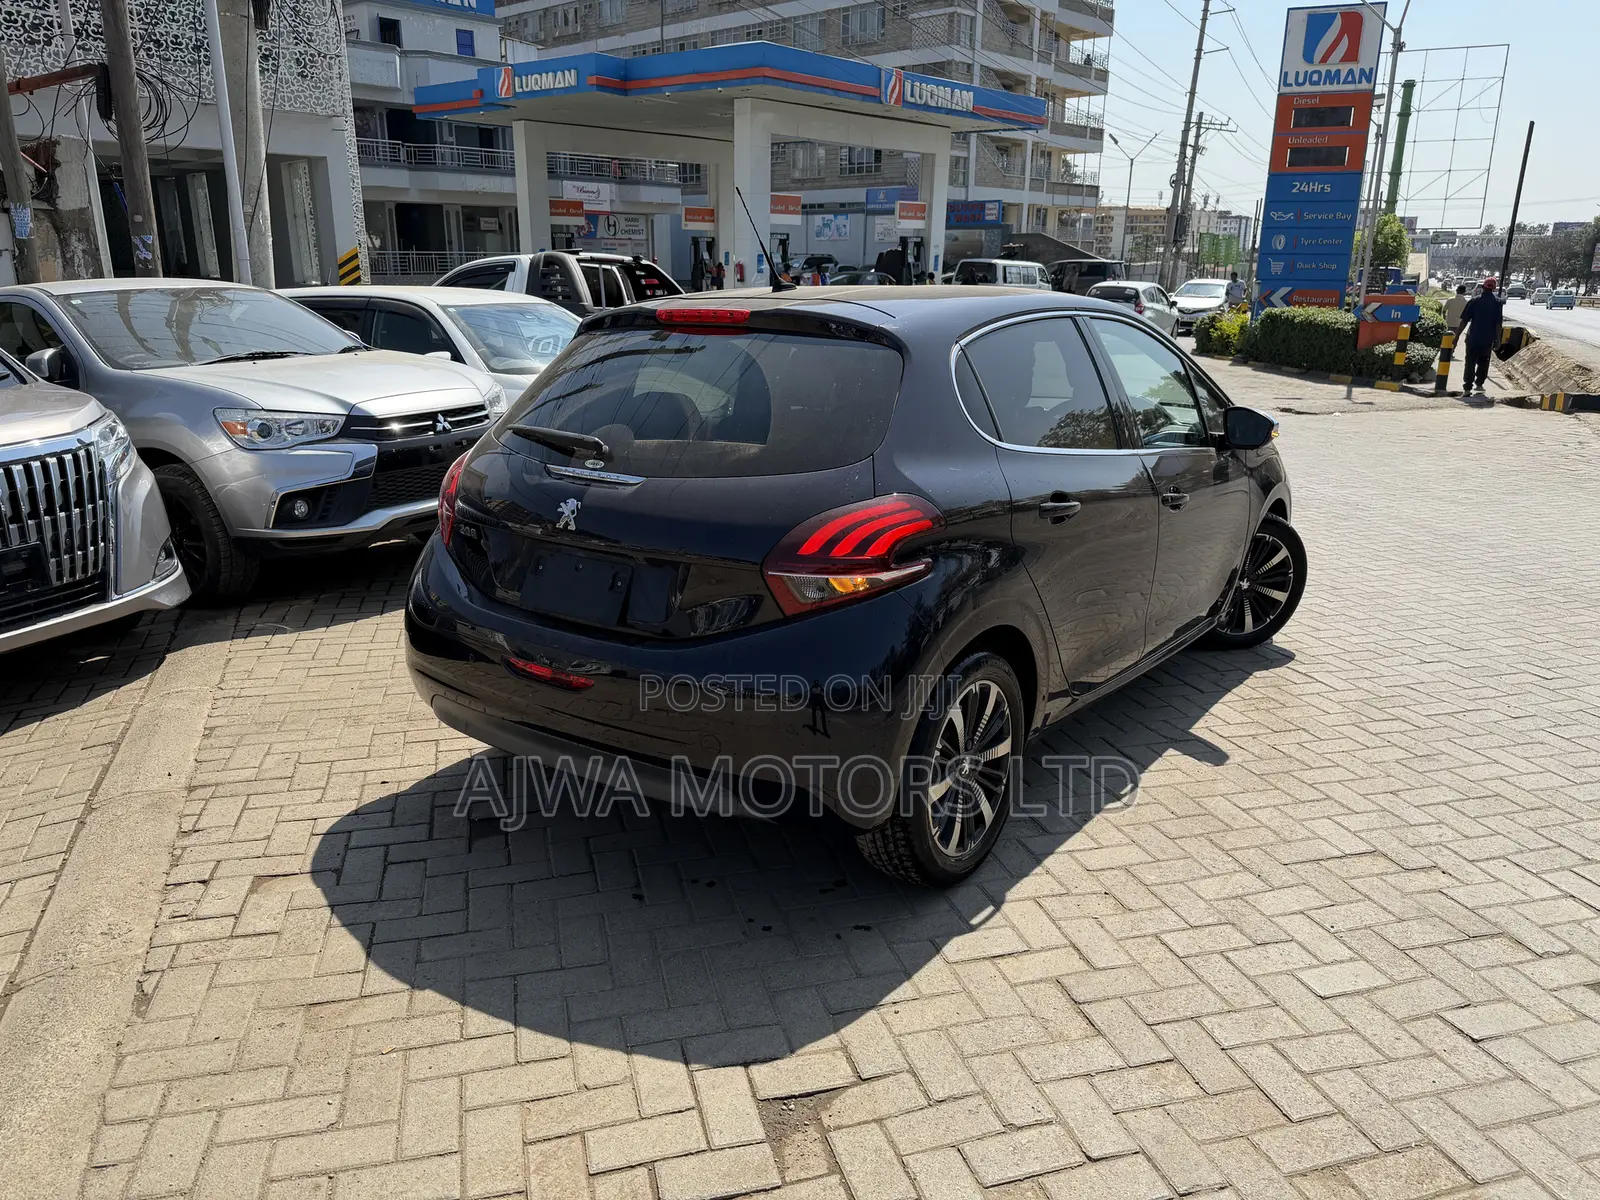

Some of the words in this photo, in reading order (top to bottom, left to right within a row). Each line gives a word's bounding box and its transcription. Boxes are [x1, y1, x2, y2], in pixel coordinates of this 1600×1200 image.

[514, 69, 578, 92] LUQMAN
[1282, 67, 1374, 87] LUQMAN
[904, 80, 974, 111] LUQMAN
[1293, 96, 1320, 105] Diesel
[1288, 136, 1328, 145] Unleaded
[1291, 182, 1332, 193] 24Hrs
[1303, 212, 1334, 220] Service
[1336, 212, 1352, 221] Bay
[1301, 238, 1316, 246] Tyre
[1318, 237, 1344, 245] Center
[1319, 262, 1337, 270] Shop
[1292, 295, 1336, 304] Restaurant
[1390, 309, 1402, 319] In
